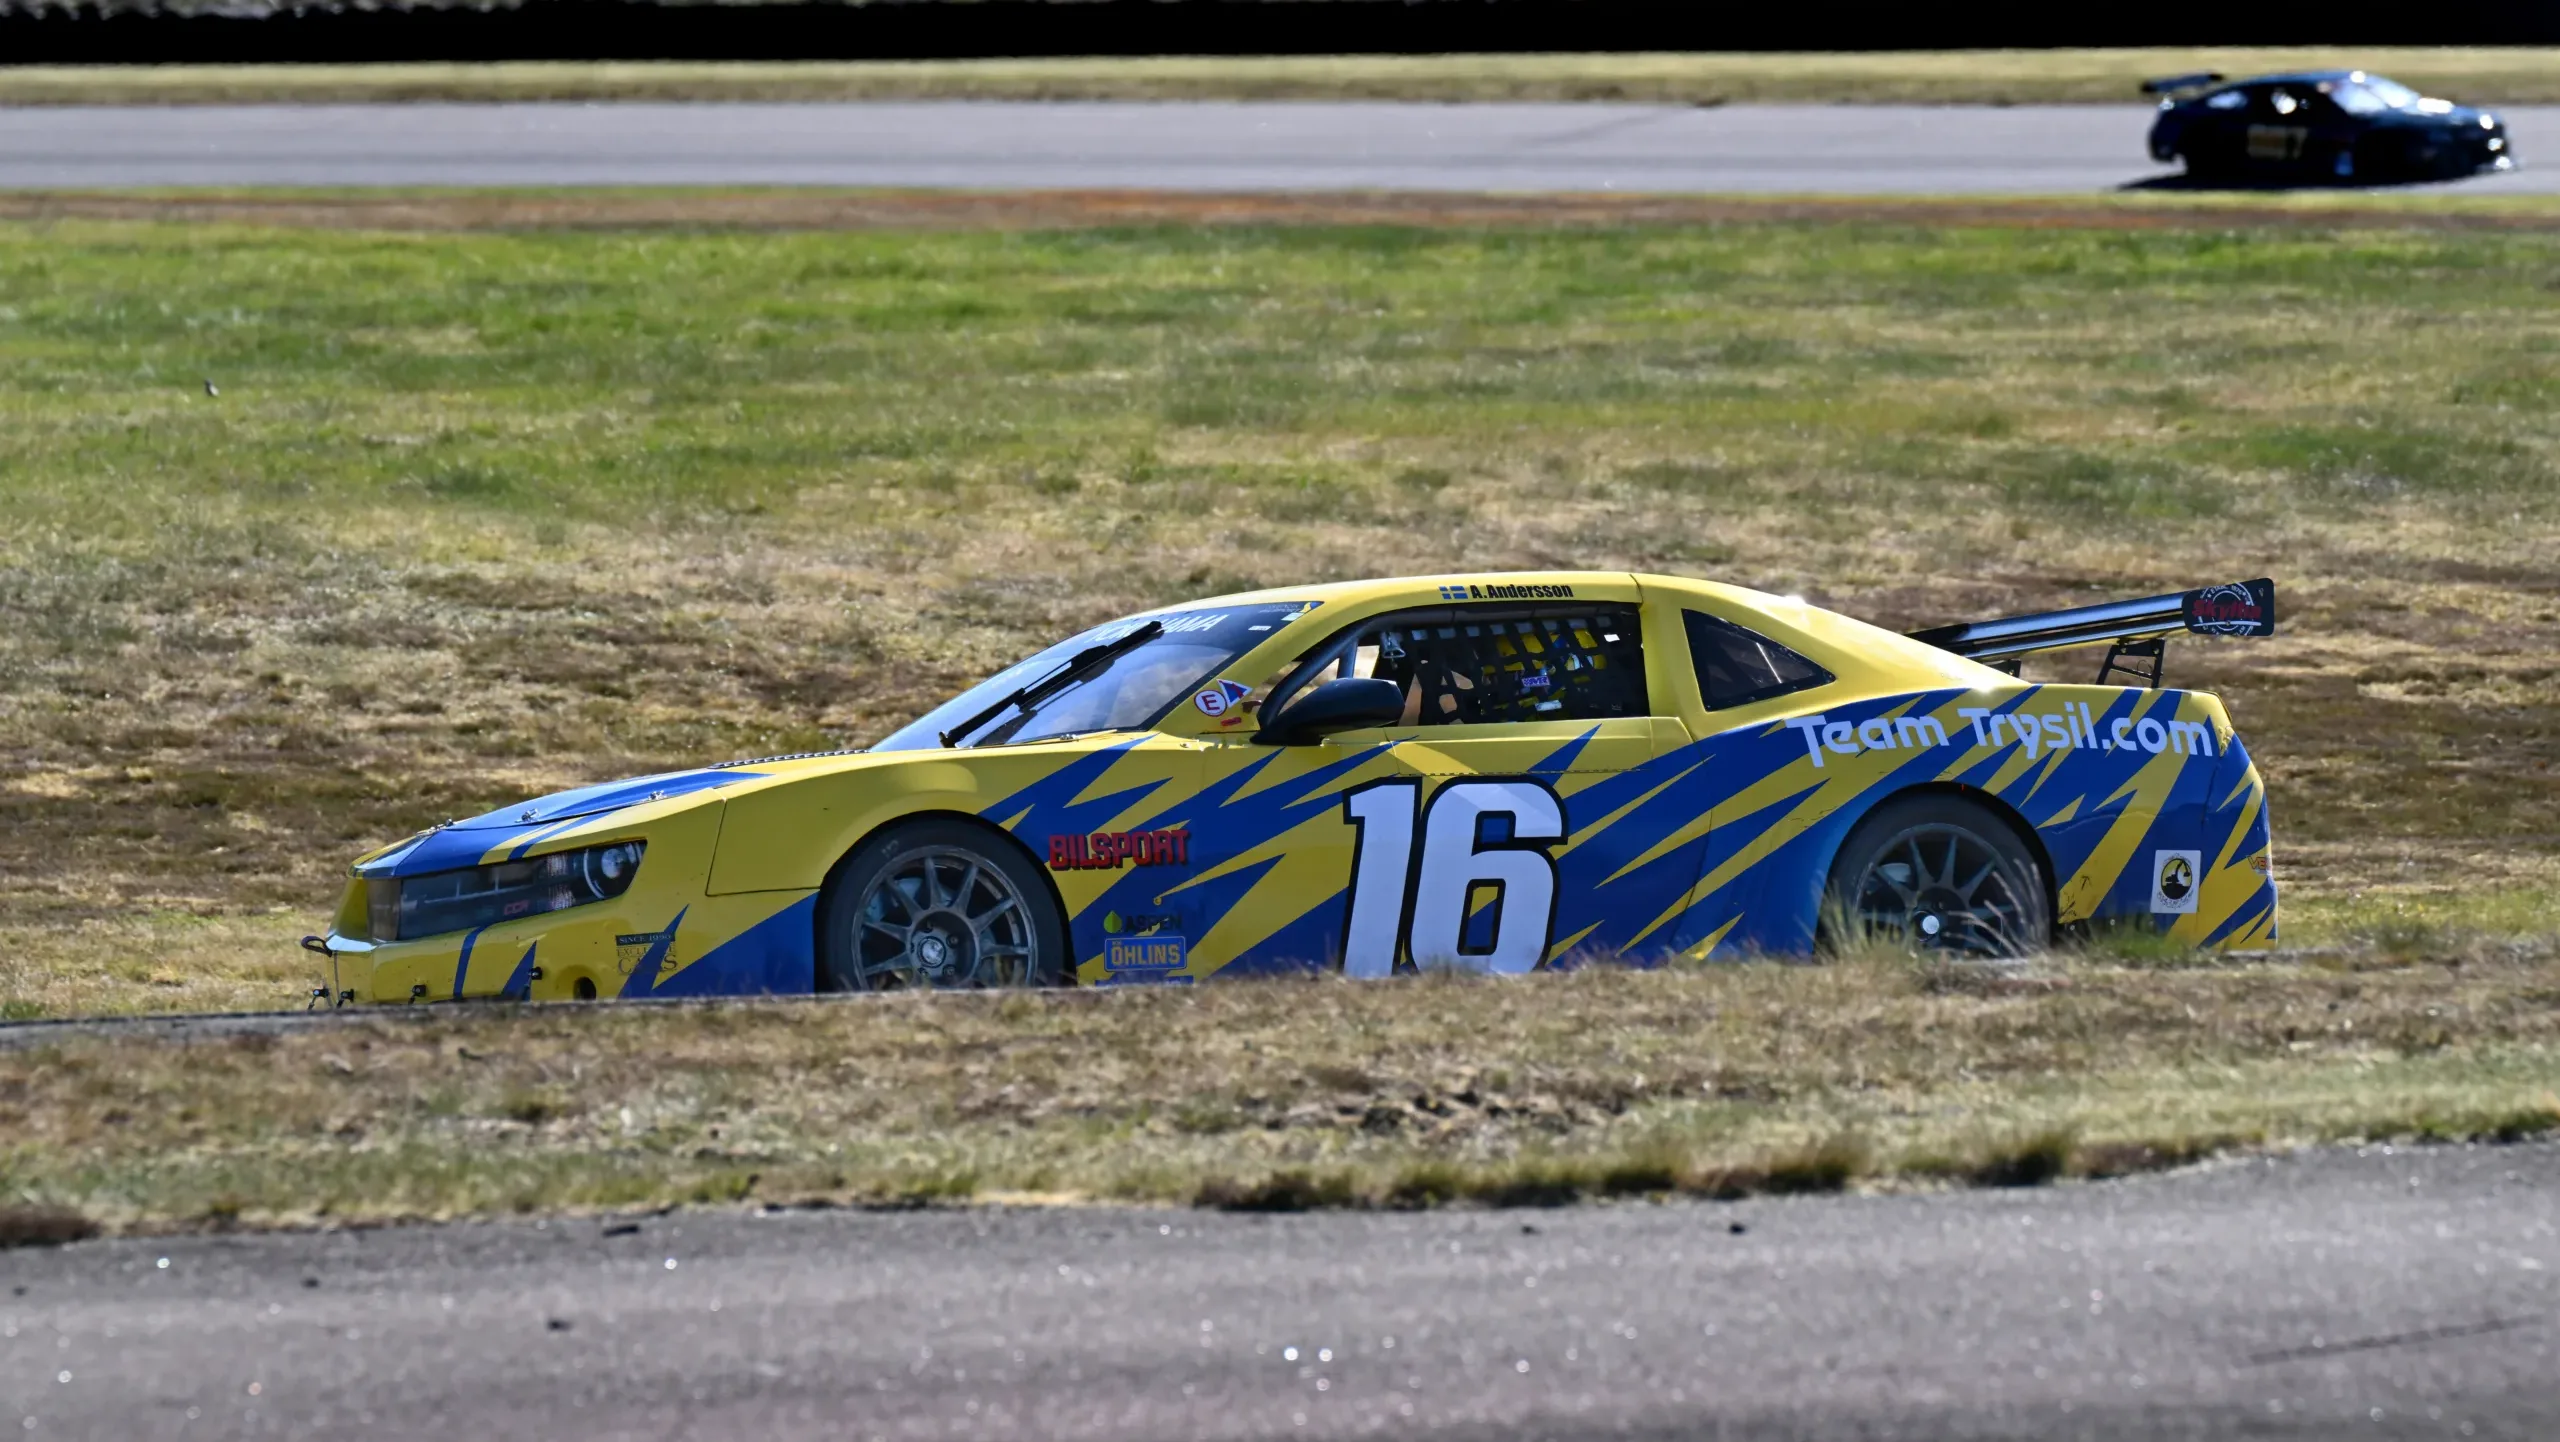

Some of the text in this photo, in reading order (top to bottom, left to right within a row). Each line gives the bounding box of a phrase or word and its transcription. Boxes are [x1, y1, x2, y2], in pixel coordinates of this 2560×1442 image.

[1469, 584, 1574, 599] A.Andersson
[1201, 694, 1220, 711] E
[1785, 701, 2213, 768] Team Trysil.com
[1049, 830, 1190, 870] BILSPORT
[1339, 776, 1568, 976] 16
[1125, 913, 1182, 933] ASPEN
[619, 936, 645, 944] SINCE
[1111, 940, 1181, 966] ÖHLINS
[618, 955, 679, 976] CS
